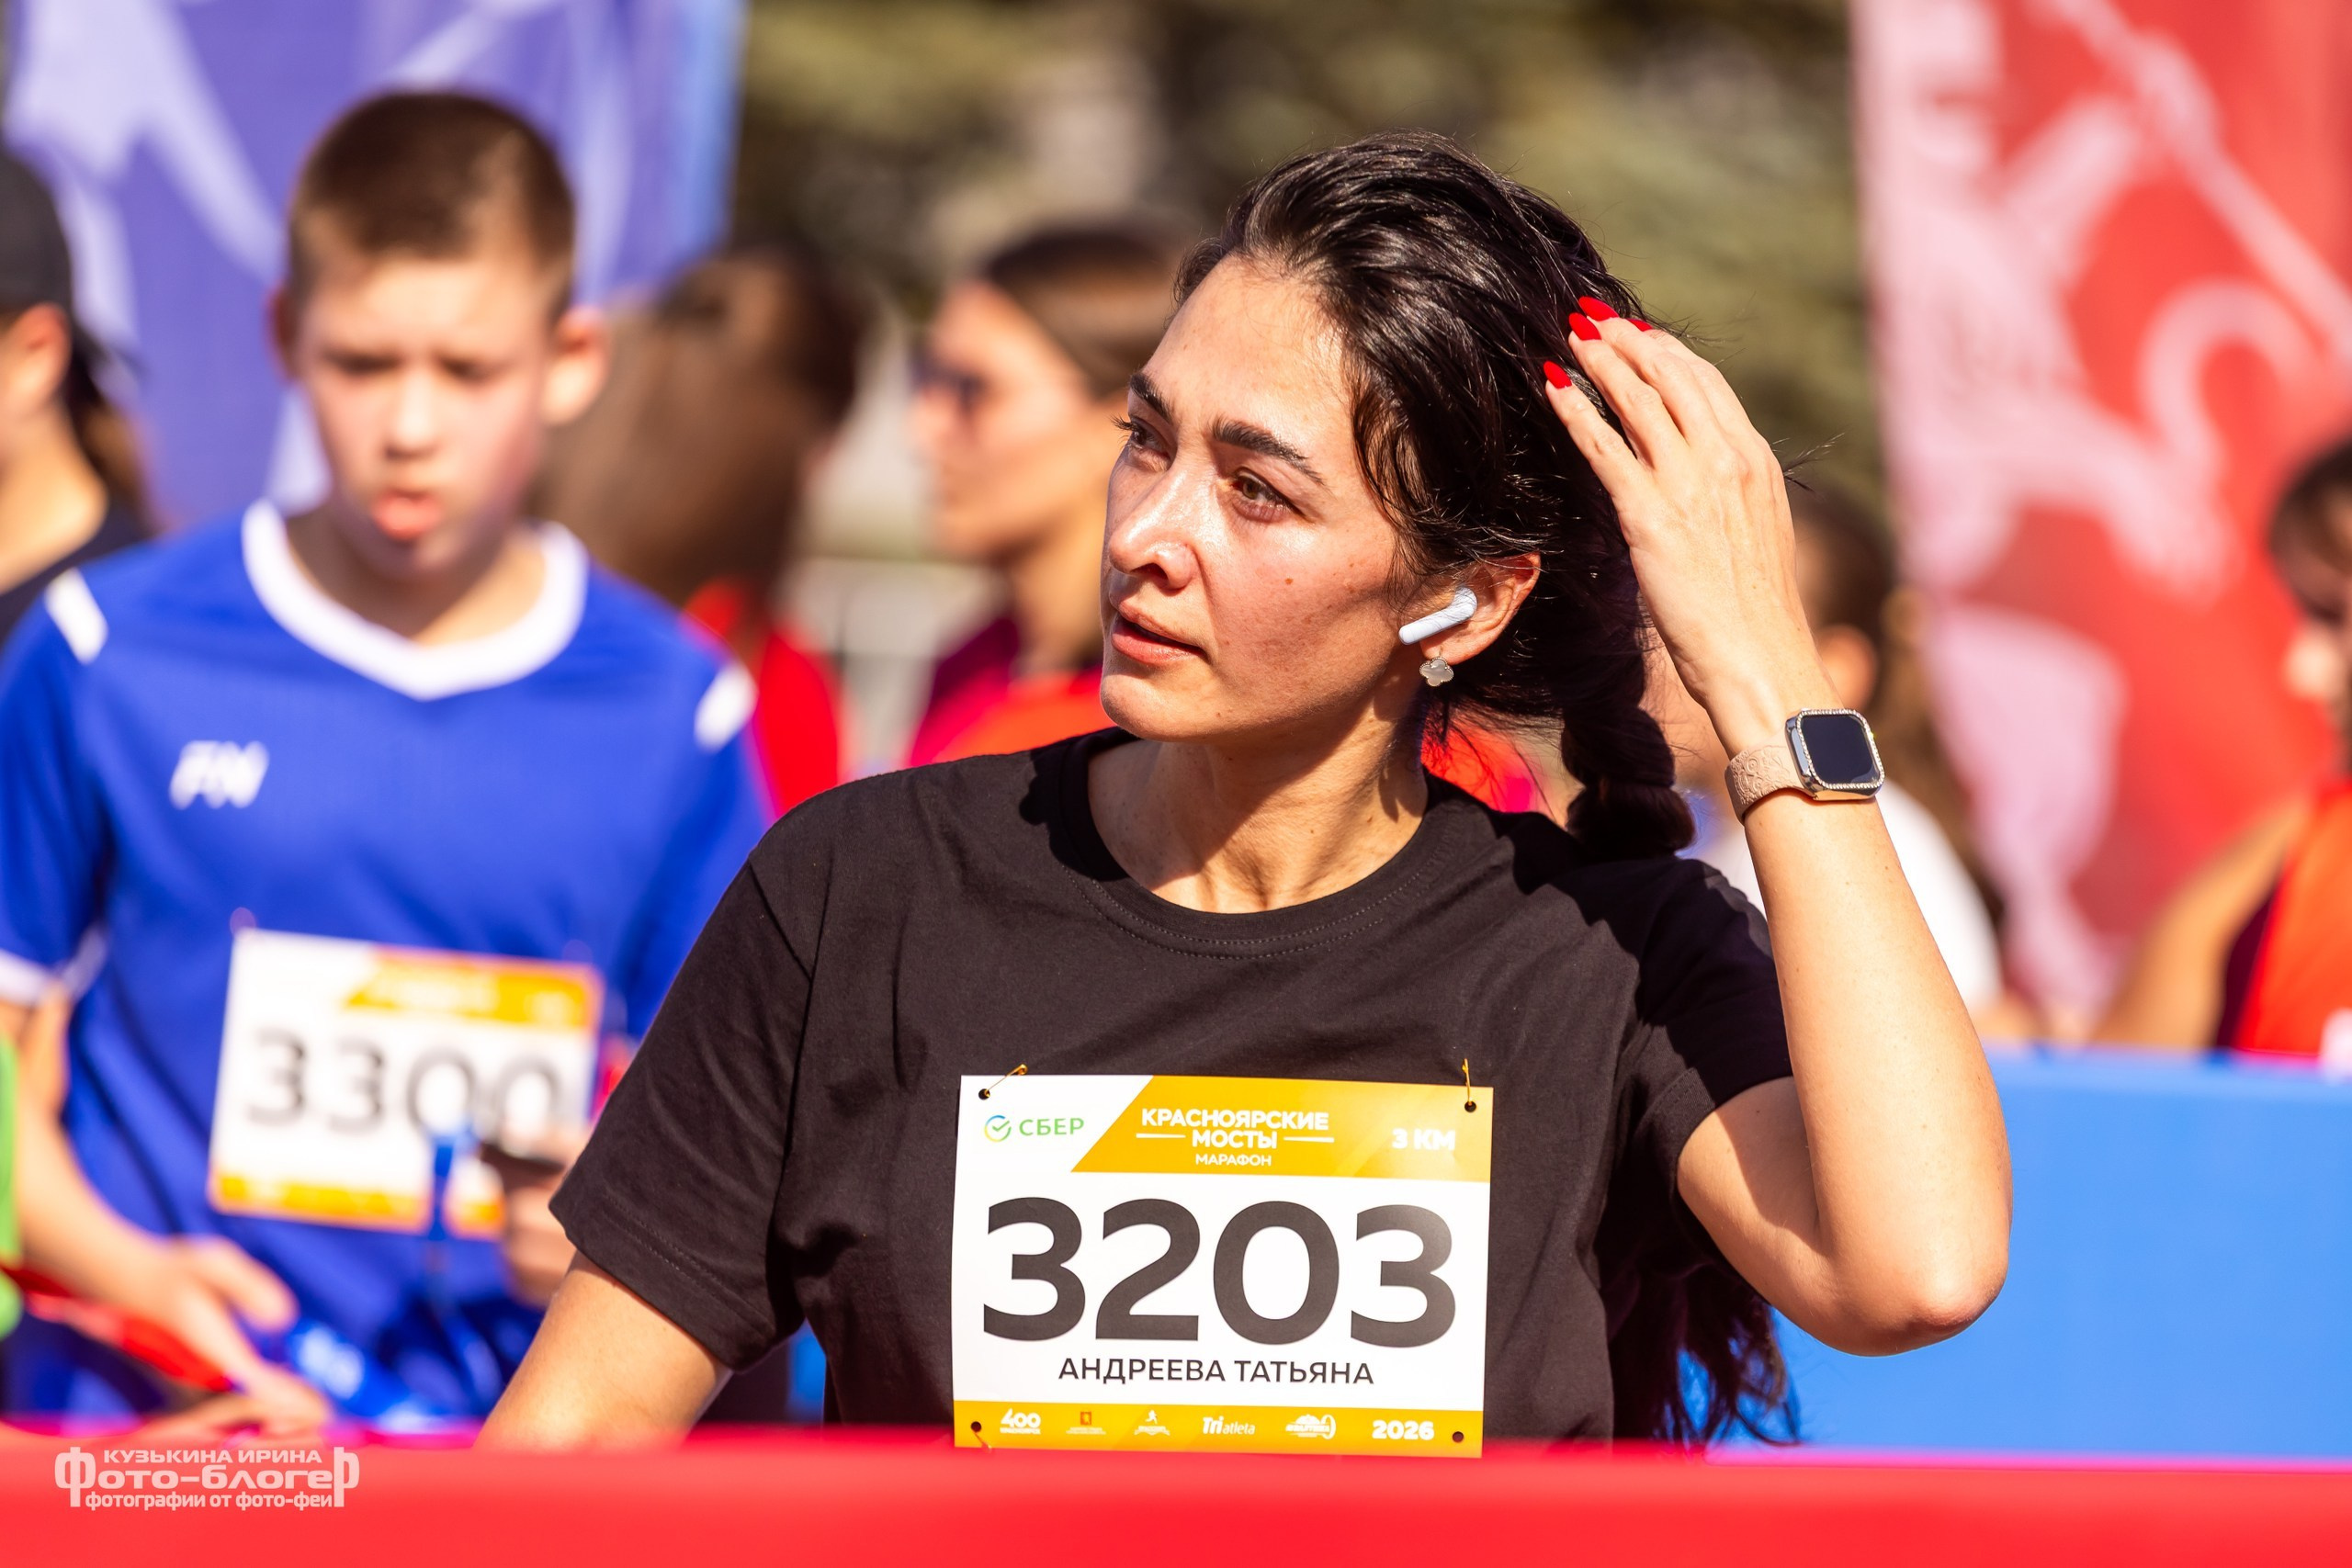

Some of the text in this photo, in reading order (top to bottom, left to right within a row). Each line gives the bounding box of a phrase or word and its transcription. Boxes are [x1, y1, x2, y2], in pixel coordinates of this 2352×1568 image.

[1019, 1118, 1084, 1135] СБЕР
[1141, 1108, 1329, 1131] КРАСНОЯРСКИЕ
[1192, 1130, 1277, 1149] МОСТЫ
[1392, 1128, 1456, 1151] 3 КМ
[1195, 1154, 1272, 1167] МАРАФОН
[983, 1196, 1456, 1348] 3203
[1058, 1358, 1374, 1385] АНДРЕЕВА ТАТЬЯНА
[1000, 1408, 1042, 1428] 400
[1372, 1420, 1435, 1440] 2026
